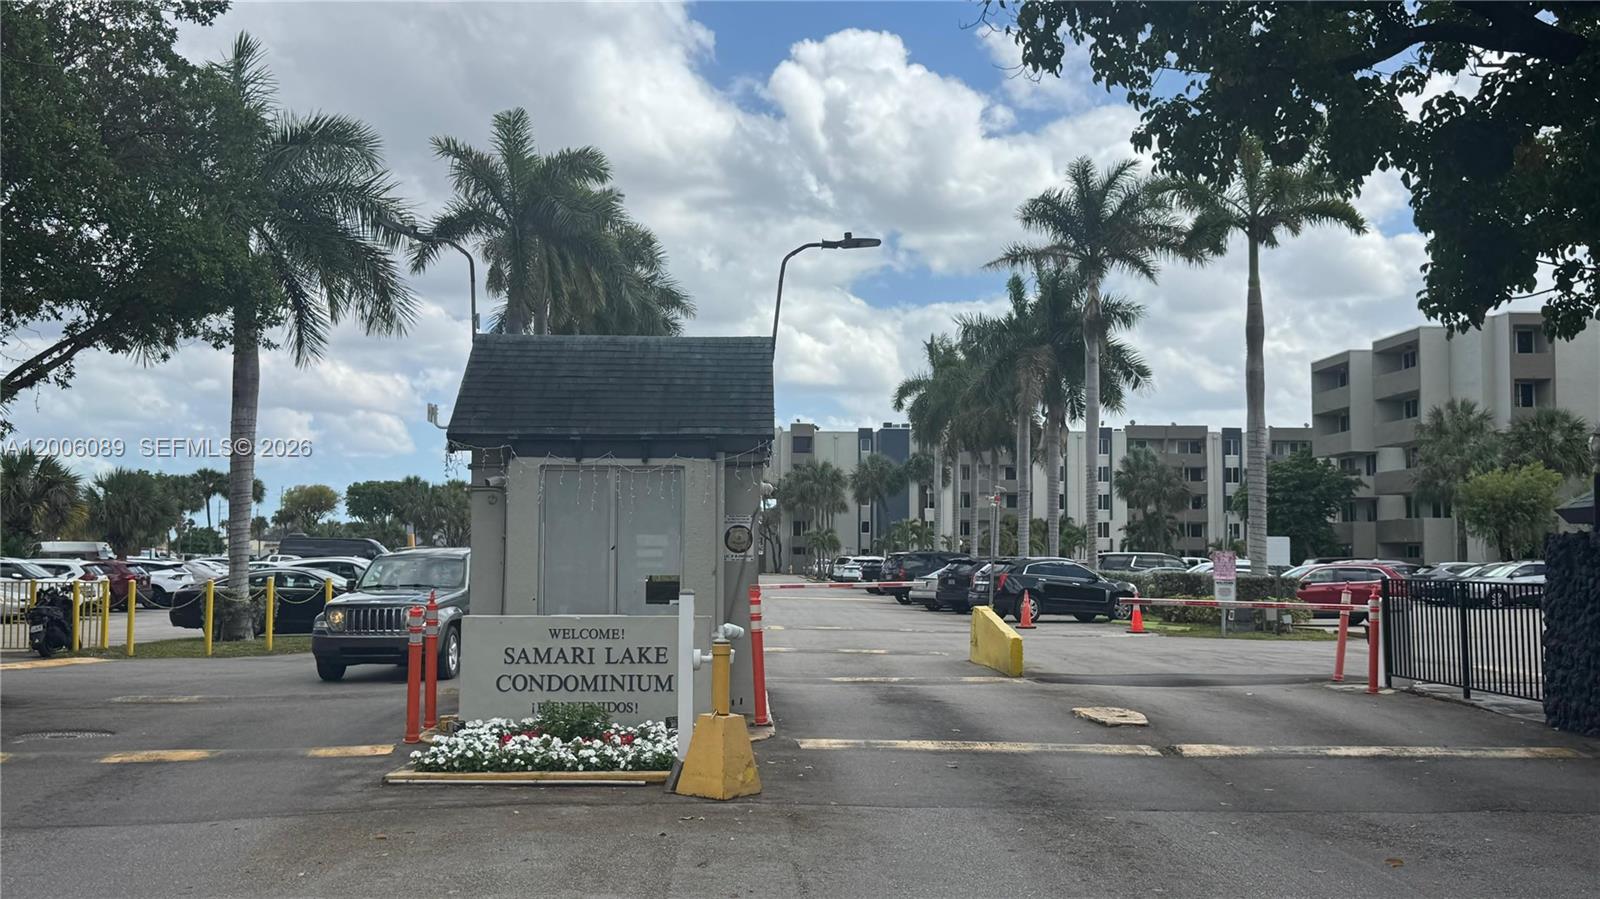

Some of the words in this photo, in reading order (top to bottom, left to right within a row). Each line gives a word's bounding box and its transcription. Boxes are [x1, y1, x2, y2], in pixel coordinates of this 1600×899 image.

[549, 628, 625, 640] WELCOME!
[503, 646, 596, 665] SAMARI
[605, 646, 669, 665] LAKE
[495, 674, 674, 693] CONDOMINIUM
